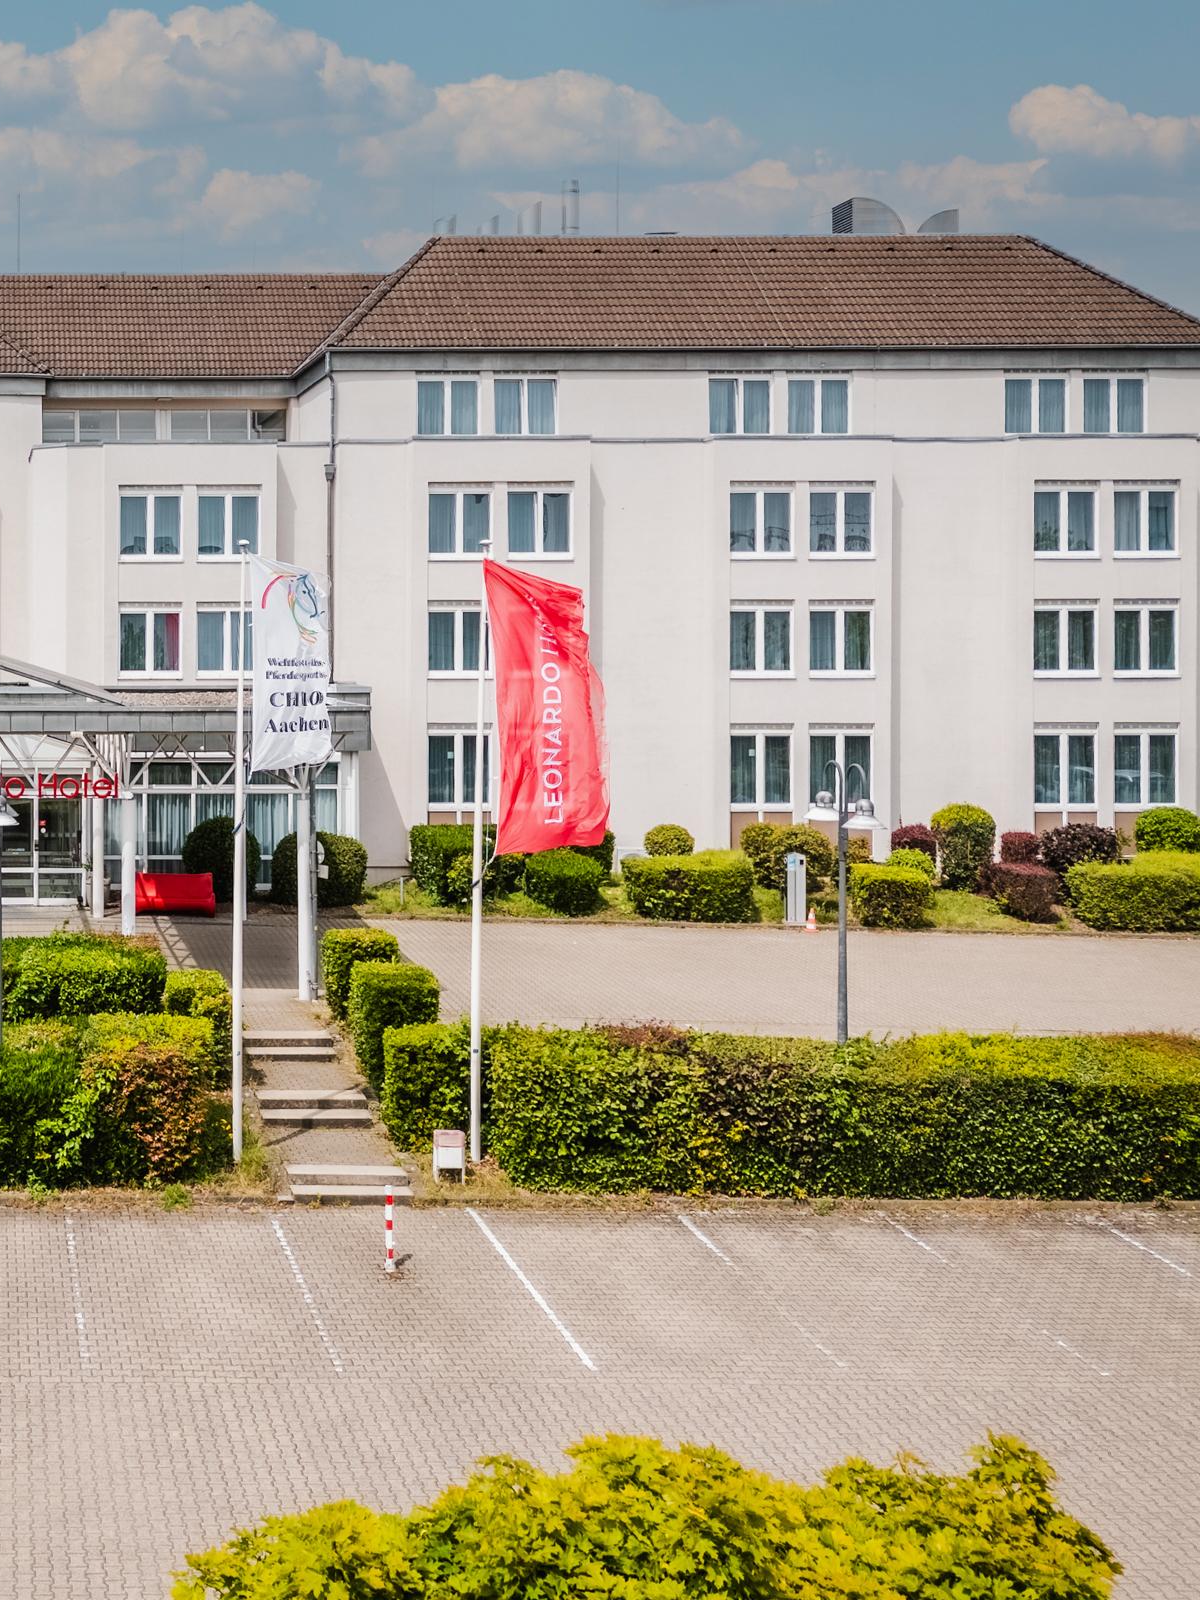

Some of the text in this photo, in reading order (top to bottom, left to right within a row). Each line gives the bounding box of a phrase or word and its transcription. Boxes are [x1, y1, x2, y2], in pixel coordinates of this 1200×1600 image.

[269, 690, 324, 708] CHIO
[264, 716, 330, 733] Aachen
[540, 662, 564, 825] LEONARDO
[38, 771, 119, 799] Hotel
